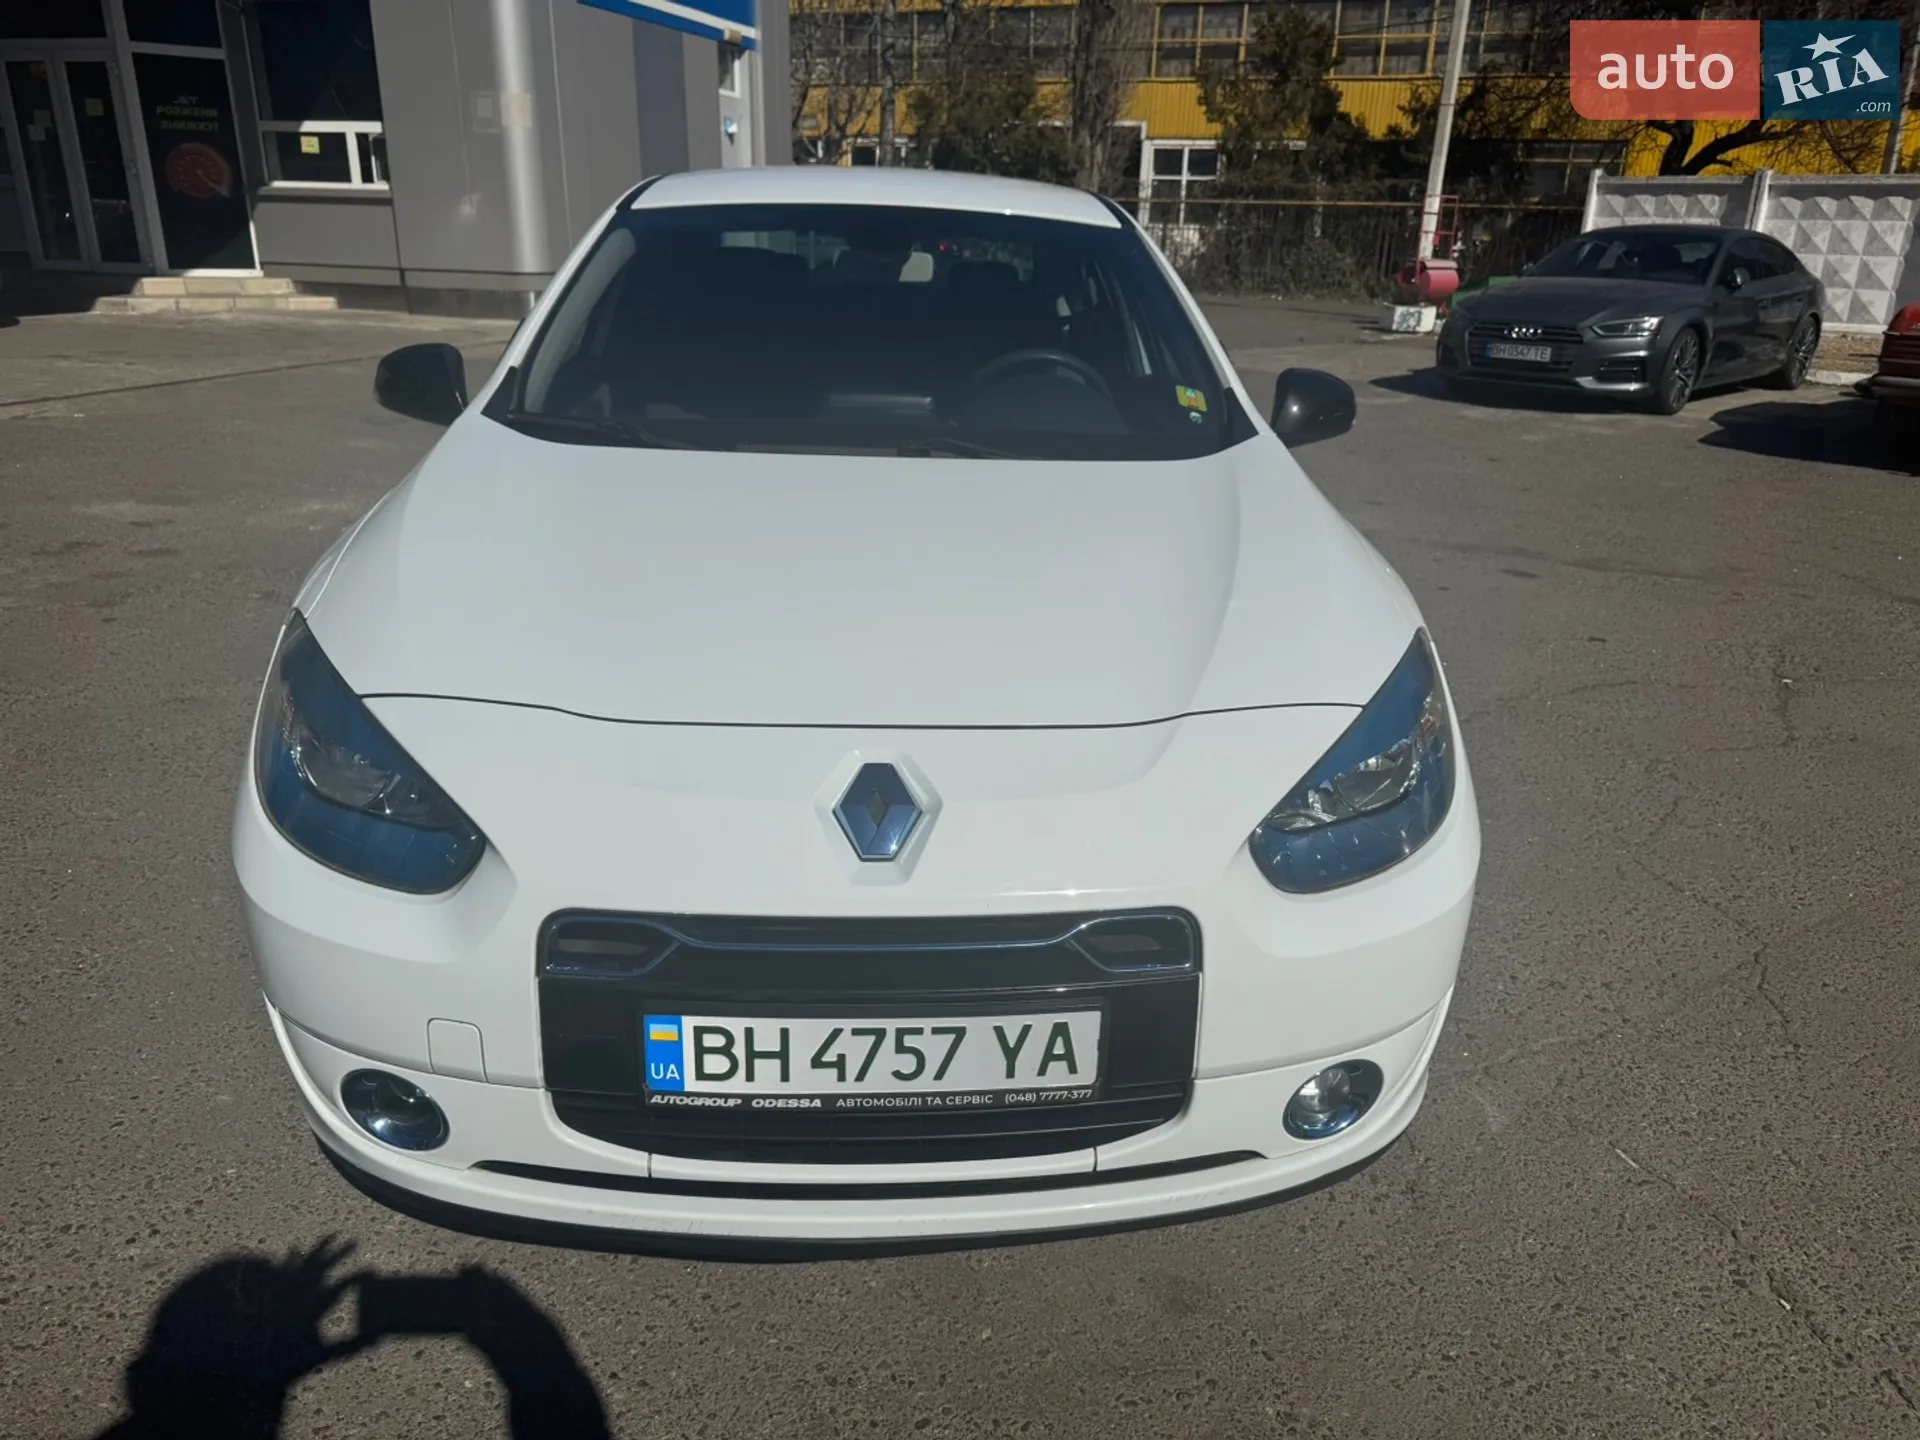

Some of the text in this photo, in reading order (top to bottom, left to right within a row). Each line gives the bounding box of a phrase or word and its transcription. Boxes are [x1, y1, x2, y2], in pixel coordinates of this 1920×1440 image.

[1534, 347, 1549, 360] TE
[693, 1021, 1079, 1082] BH 4757 YA
[650, 1062, 681, 1080] UA
[650, 1089, 1093, 1108] AUTOGROUP ODESSA АВТОМОБІЛІ ТА СЕРВІС (048) 7777-377
